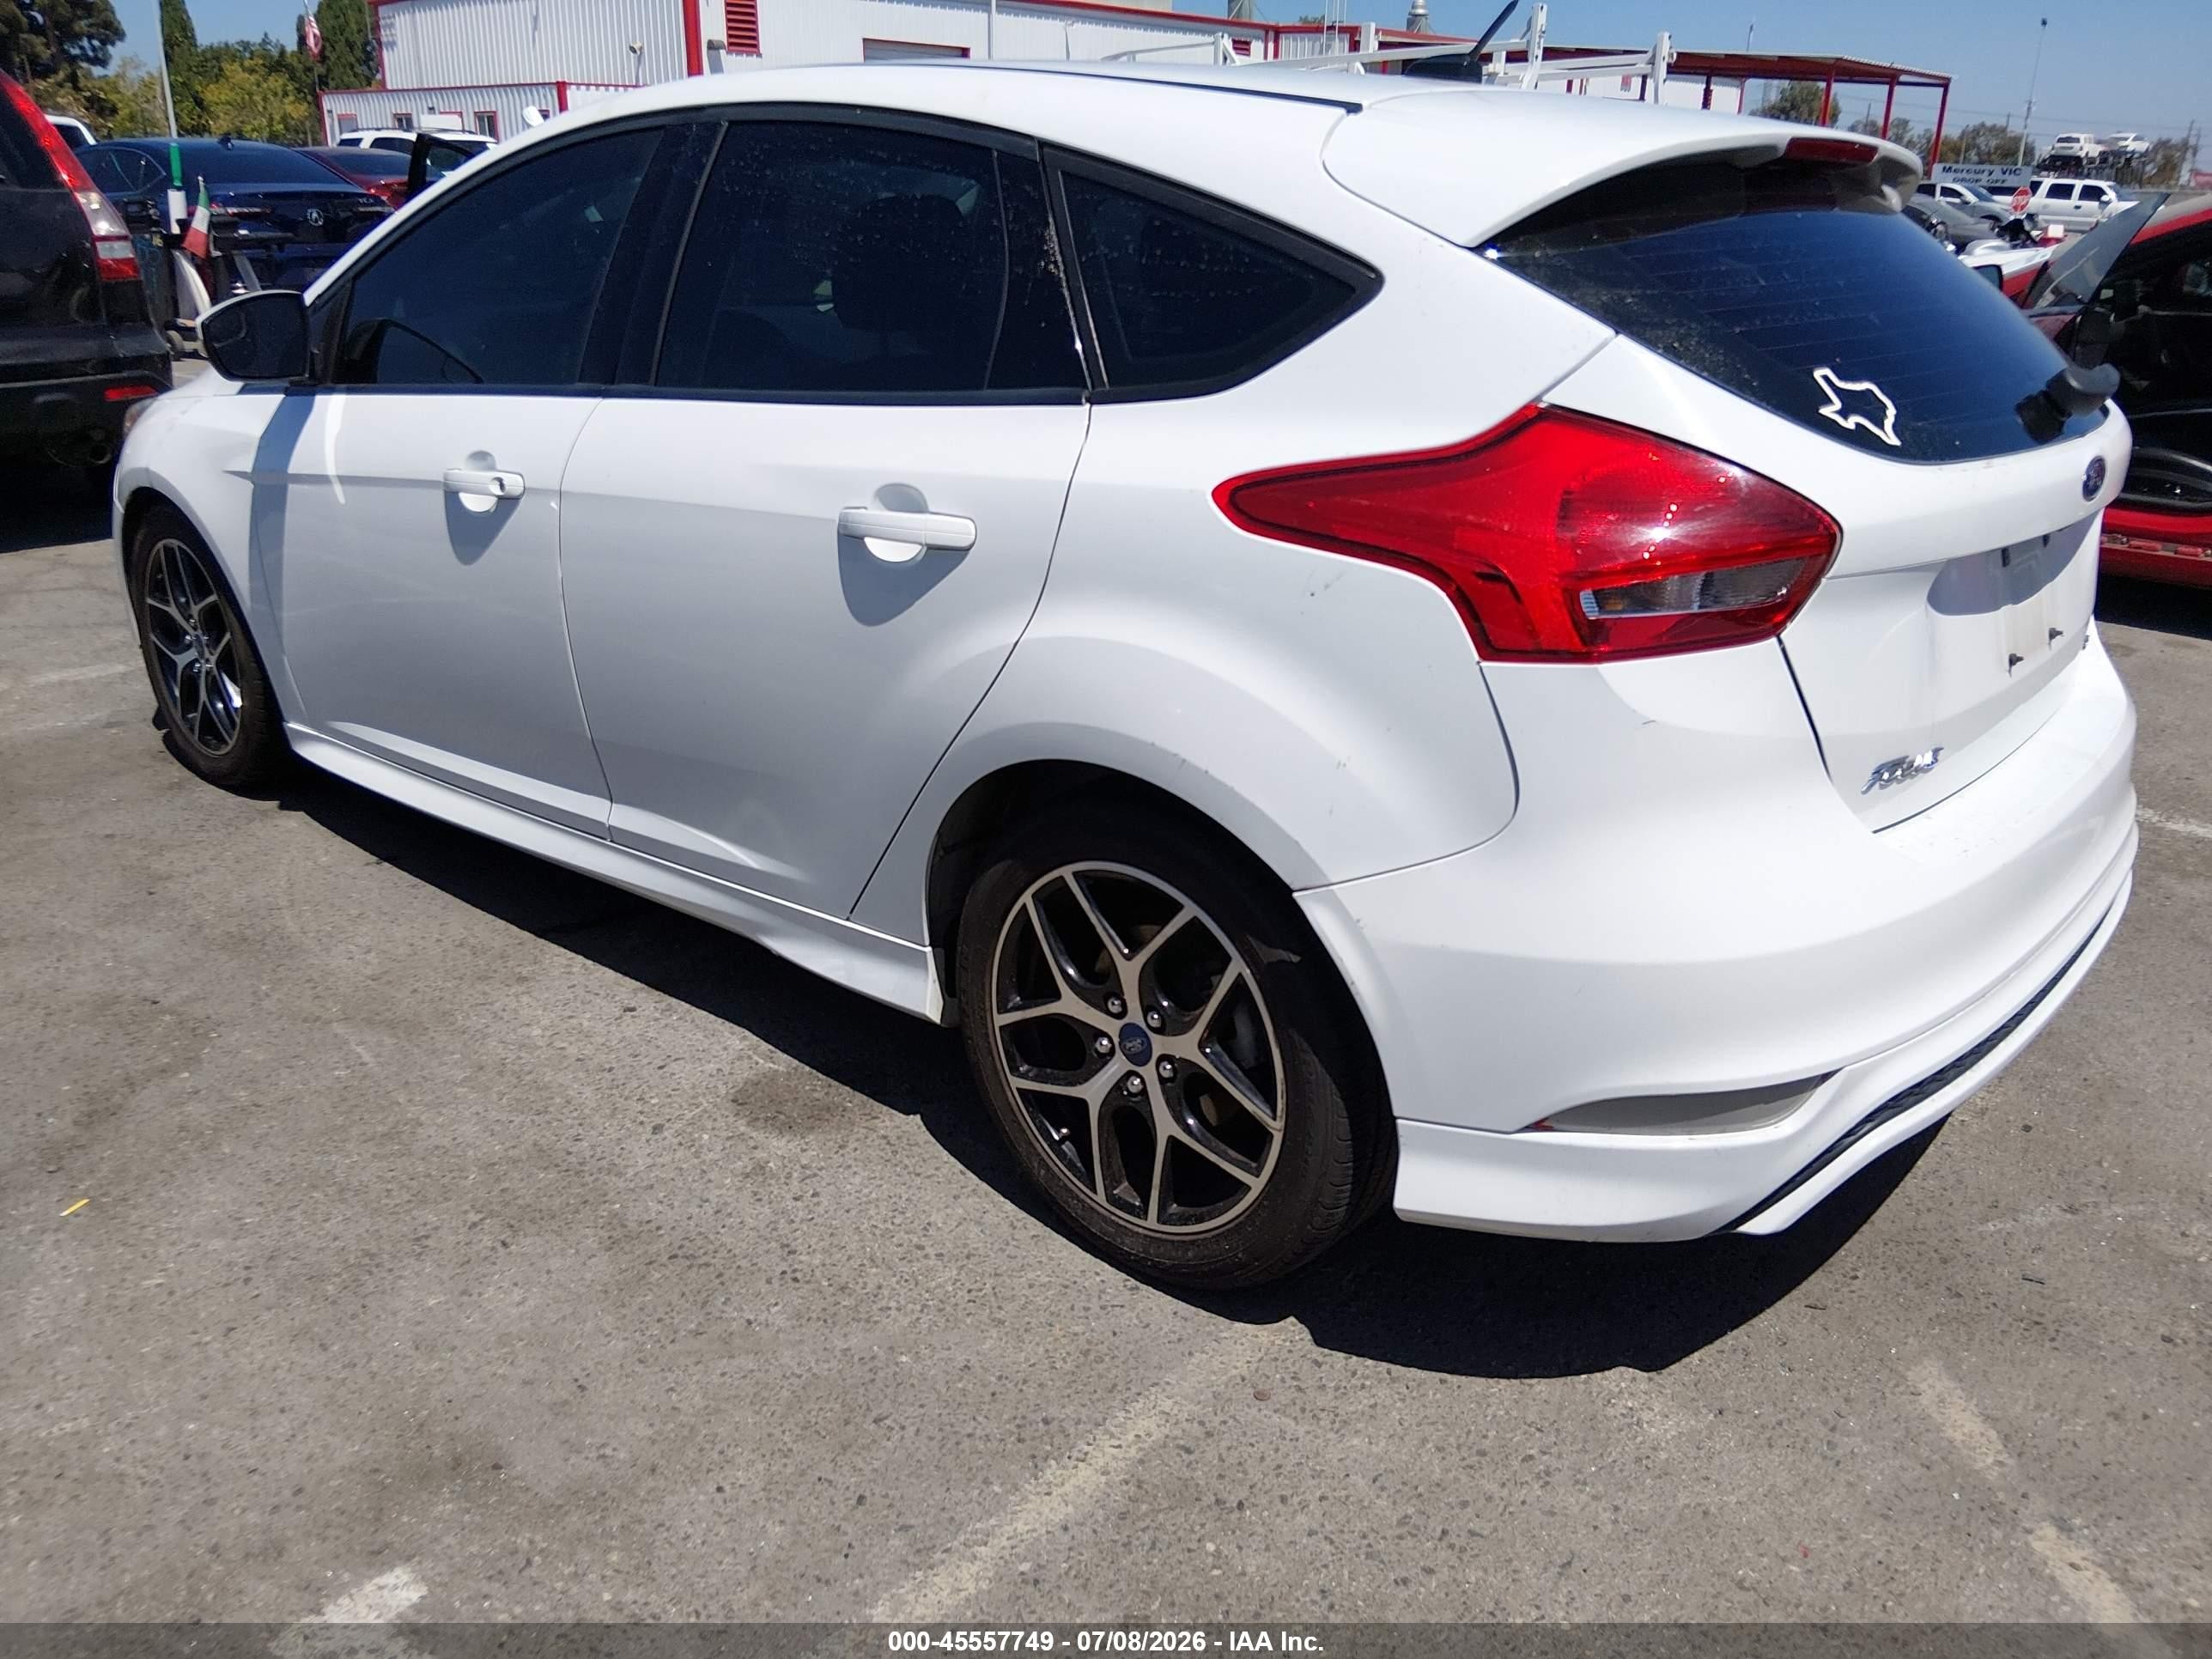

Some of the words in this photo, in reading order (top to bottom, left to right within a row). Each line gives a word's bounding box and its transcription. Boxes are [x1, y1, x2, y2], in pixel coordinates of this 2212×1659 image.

[1942, 166, 1995, 176] Mercury
[2001, 167, 2022, 176] VIC
[2013, 195, 2030, 207] STOP
